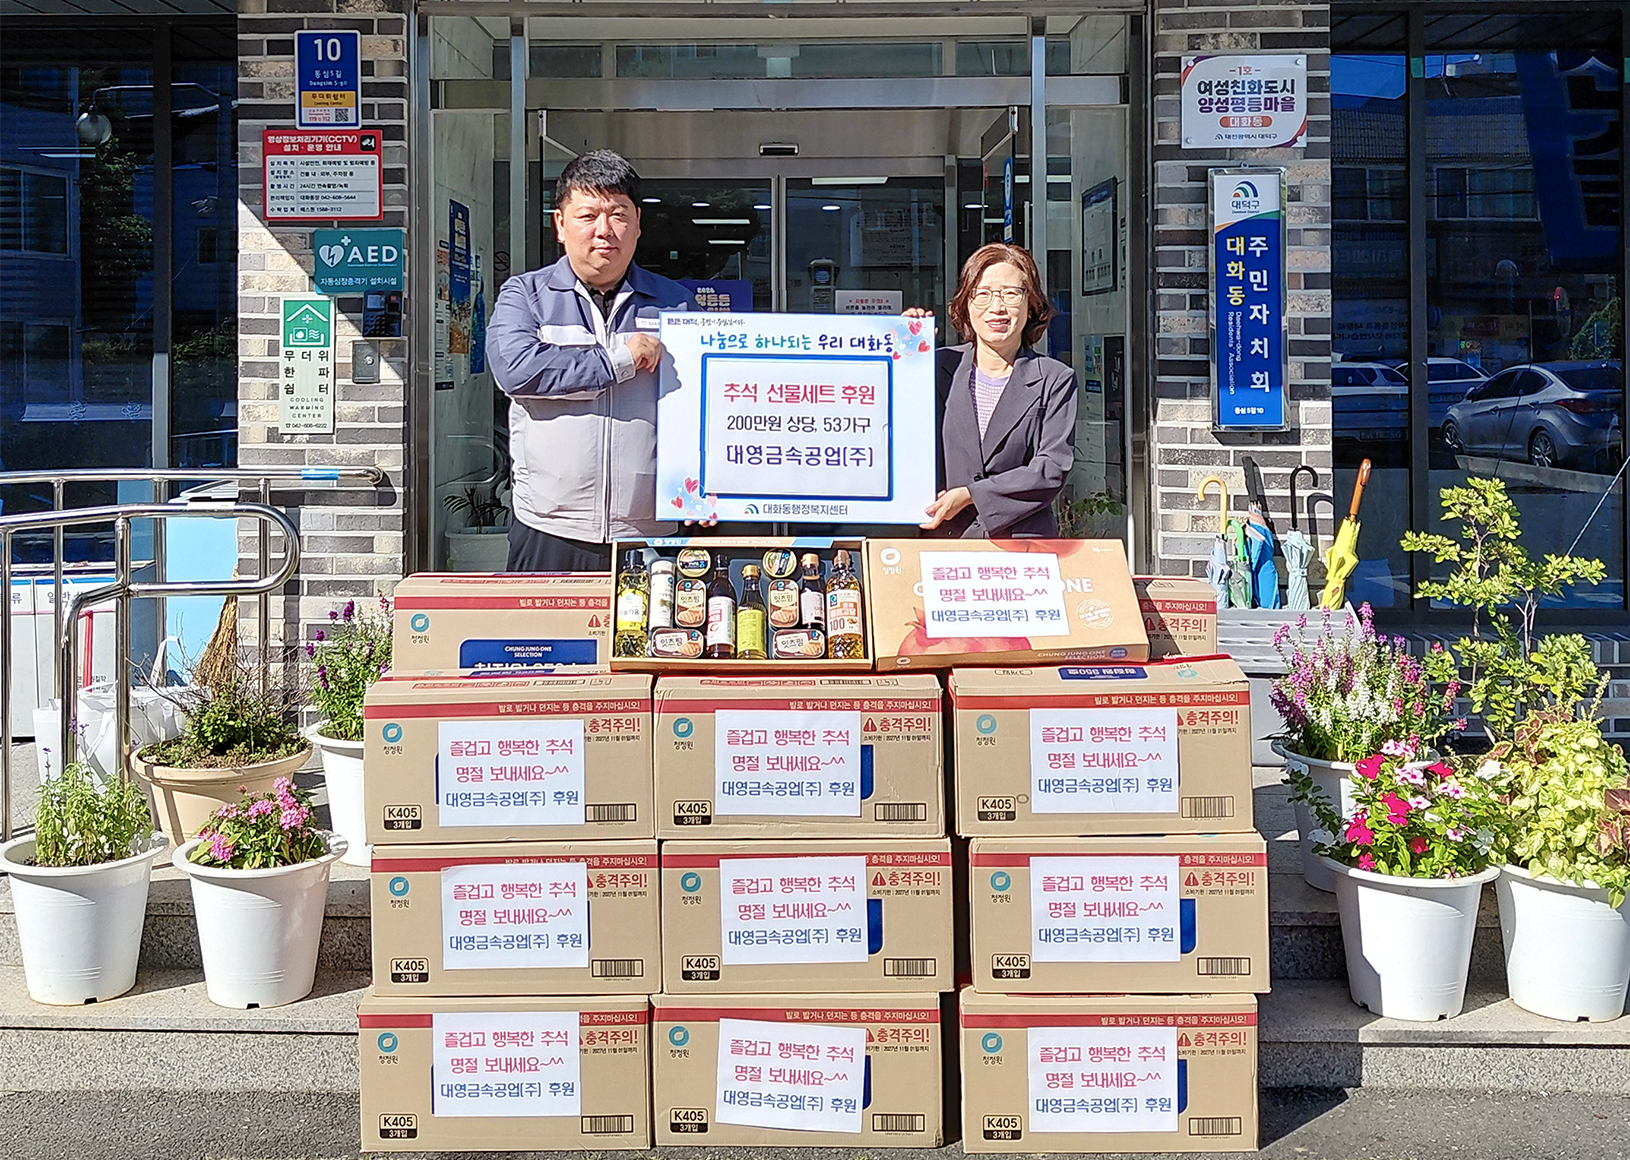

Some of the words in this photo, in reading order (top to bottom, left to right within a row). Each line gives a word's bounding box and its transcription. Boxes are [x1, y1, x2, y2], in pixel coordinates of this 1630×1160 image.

[313, 38, 341, 61] 10
[1198, 79, 1295, 95] 여성친화도시
[1198, 96, 1295, 113] 양성평등마을
[1229, 116, 1263, 127] 대화동
[1232, 201, 1259, 209] 대덕구
[347, 246, 397, 262] AED
[1226, 236, 1246, 306] 대화동
[320, 278, 367, 286] 자동심장충격기
[370, 277, 396, 285] 설치시설
[1248, 236, 1270, 393] 주민자치회
[701, 332, 748, 349] 나눔으로
[755, 333, 812, 350] 하나되는
[818, 333, 842, 349] 우리
[850, 333, 894, 352] 대화동
[284, 350, 328, 361] 무더위
[724, 383, 758, 403] 추석
[766, 383, 836, 404] 선물세트
[841, 385, 875, 404] 후원
[727, 416, 782, 432] 200만원
[786, 416, 818, 433] 상당,
[823, 417, 871, 434] 53가구
[726, 445, 874, 467] 대영금속공업(주)
[763, 504, 848, 516] 대화동행정복지센터
[932, 567, 972, 580] 즐겁고
[977, 567, 1017, 580] 행복한
[1023, 567, 1049, 579] 추석
[940, 589, 966, 602] 명절
[932, 610, 1028, 622] 대영금속공업(주)
[1036, 609, 1060, 620] 후원
[830, 618, 845, 631] 100
[411, 635, 430, 644] 청정원
[886, 700, 931, 710] 주지마십시오!
[879, 717, 931, 732] 충격주의!
[727, 730, 768, 745] 즐겁고
[774, 730, 816, 746] 행복한
[822, 730, 849, 746] 추석
[1042, 727, 1083, 742] 즐겁고
[1090, 727, 1132, 743] 행복한
[1139, 726, 1165, 742] 추석
[383, 745, 403, 755] 청정원
[450, 741, 491, 756] 즐겁고
[498, 740, 540, 756] 행복한
[546, 739, 573, 755] 추석
[733, 756, 759, 771] 명절
[1048, 753, 1075, 769] 명절
[456, 767, 483, 783] 명절
[723, 781, 821, 796] 대영금속공업(주)
[829, 782, 854, 796] 후원
[1038, 778, 1139, 793] 대영금속공업(주)
[1147, 778, 1172, 792] 후원
[446, 791, 545, 807] 대영금속공업(주)
[553, 791, 578, 805] 후원
[981, 799, 1012, 809] K405
[388, 808, 418, 818] K405
[678, 804, 708, 814] K405
[732, 878, 773, 894] 즐겁고
[780, 877, 822, 893] 행복한
[828, 876, 855, 892] 추석
[888, 871, 941, 886] 충격주의!
[1042, 876, 1084, 892] 즐겁고
[1091, 876, 1133, 892] 행복한
[1140, 876, 1167, 891] 추석
[1201, 871, 1255, 886] 충격주의!
[453, 884, 494, 900] 즐겁고
[501, 883, 543, 899] 행복한
[549, 882, 576, 898] 추석
[739, 905, 765, 920] 명절
[1049, 902, 1076, 918] 명절
[460, 910, 486, 926] 명절
[450, 934, 549, 950] 대영금속공업(주)
[557, 934, 582, 948] 후원
[729, 929, 828, 945] 대영금속공업(주)
[836, 928, 861, 942] 후원
[1039, 928, 1140, 943] 대영금속공업(주)
[1148, 928, 1173, 942] 후원
[395, 961, 425, 971] K405
[686, 958, 716, 968] K405
[996, 956, 1026, 967] K405
[445, 1032, 486, 1048] 즐겁고
[493, 1031, 535, 1047] 행복한
[541, 1031, 568, 1046] 추석
[877, 1028, 930, 1043] 충격주의!
[1194, 1032, 1247, 1046] 충격주의!
[730, 1039, 771, 1056] 즐겁고
[778, 1043, 820, 1060] 행복한
[826, 1047, 853, 1063] 추석
[1040, 1047, 1082, 1062] 즐겁고
[1089, 1047, 1131, 1062] 행복한
[1138, 1046, 1165, 1062] 추석
[451, 1058, 477, 1074] 명절
[735, 1065, 761, 1082] 명절
[1046, 1073, 1073, 1088] 명절
[441, 1082, 541, 1098] 대영금속공업(주)
[549, 1082, 574, 1096] 후원
[724, 1090, 823, 1111] 대영금속공업(주)
[831, 1098, 856, 1113] 후원
[1036, 1098, 1137, 1113] 대영금속공업(주)
[1145, 1098, 1171, 1112] 후원
[383, 1117, 413, 1127] K405
[674, 1111, 704, 1121] K405
[987, 1118, 1017, 1128] K405
